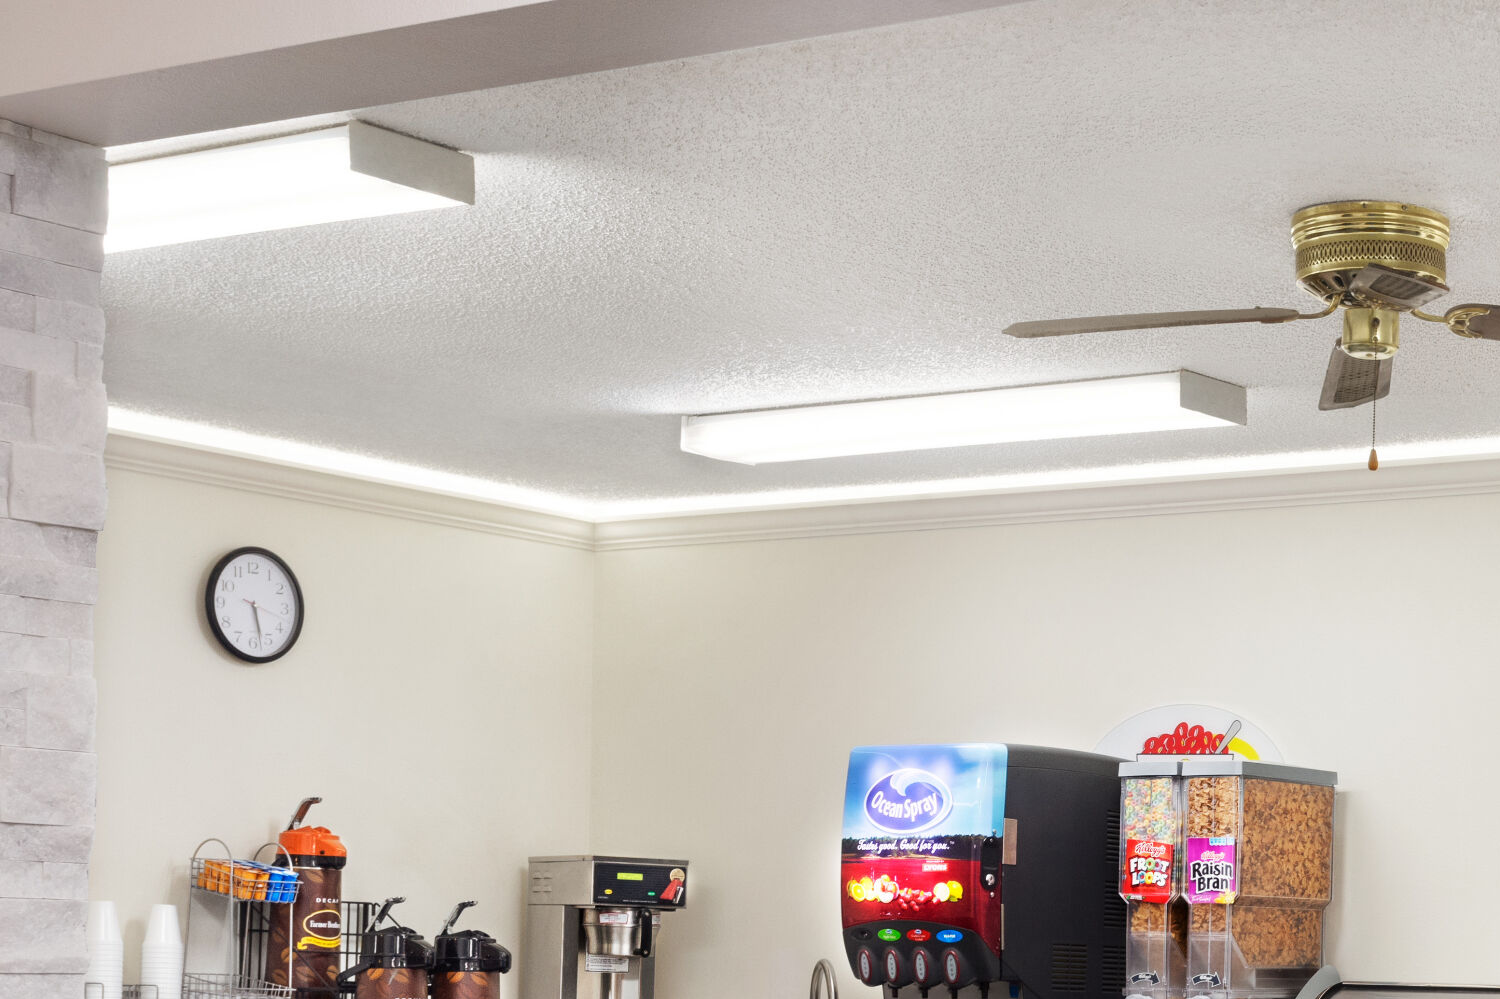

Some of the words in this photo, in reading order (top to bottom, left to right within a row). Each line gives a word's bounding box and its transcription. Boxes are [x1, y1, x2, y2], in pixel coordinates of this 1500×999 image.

[233, 566, 242, 578] 11
[248, 562, 260, 574] 12
[268, 568, 272, 582] 1
[221, 580, 235, 592] 10
[276, 584, 284, 594] 2
[216, 596, 226, 608] 9
[280, 602, 289, 615] 3
[222, 616, 231, 628] 8
[276, 622, 284, 634] 4
[234, 632, 242, 643] 7
[248, 637, 258, 650] 6
[264, 634, 272, 646] 5
[871, 791, 903, 818] Ocean
[904, 792, 938, 822] Spray
[900, 840, 918, 850] Good
[1130, 857, 1170, 872] FROOT
[1190, 861, 1233, 880] Raisin
[1132, 871, 1168, 886] LOOPS
[1196, 876, 1230, 893] Bran
